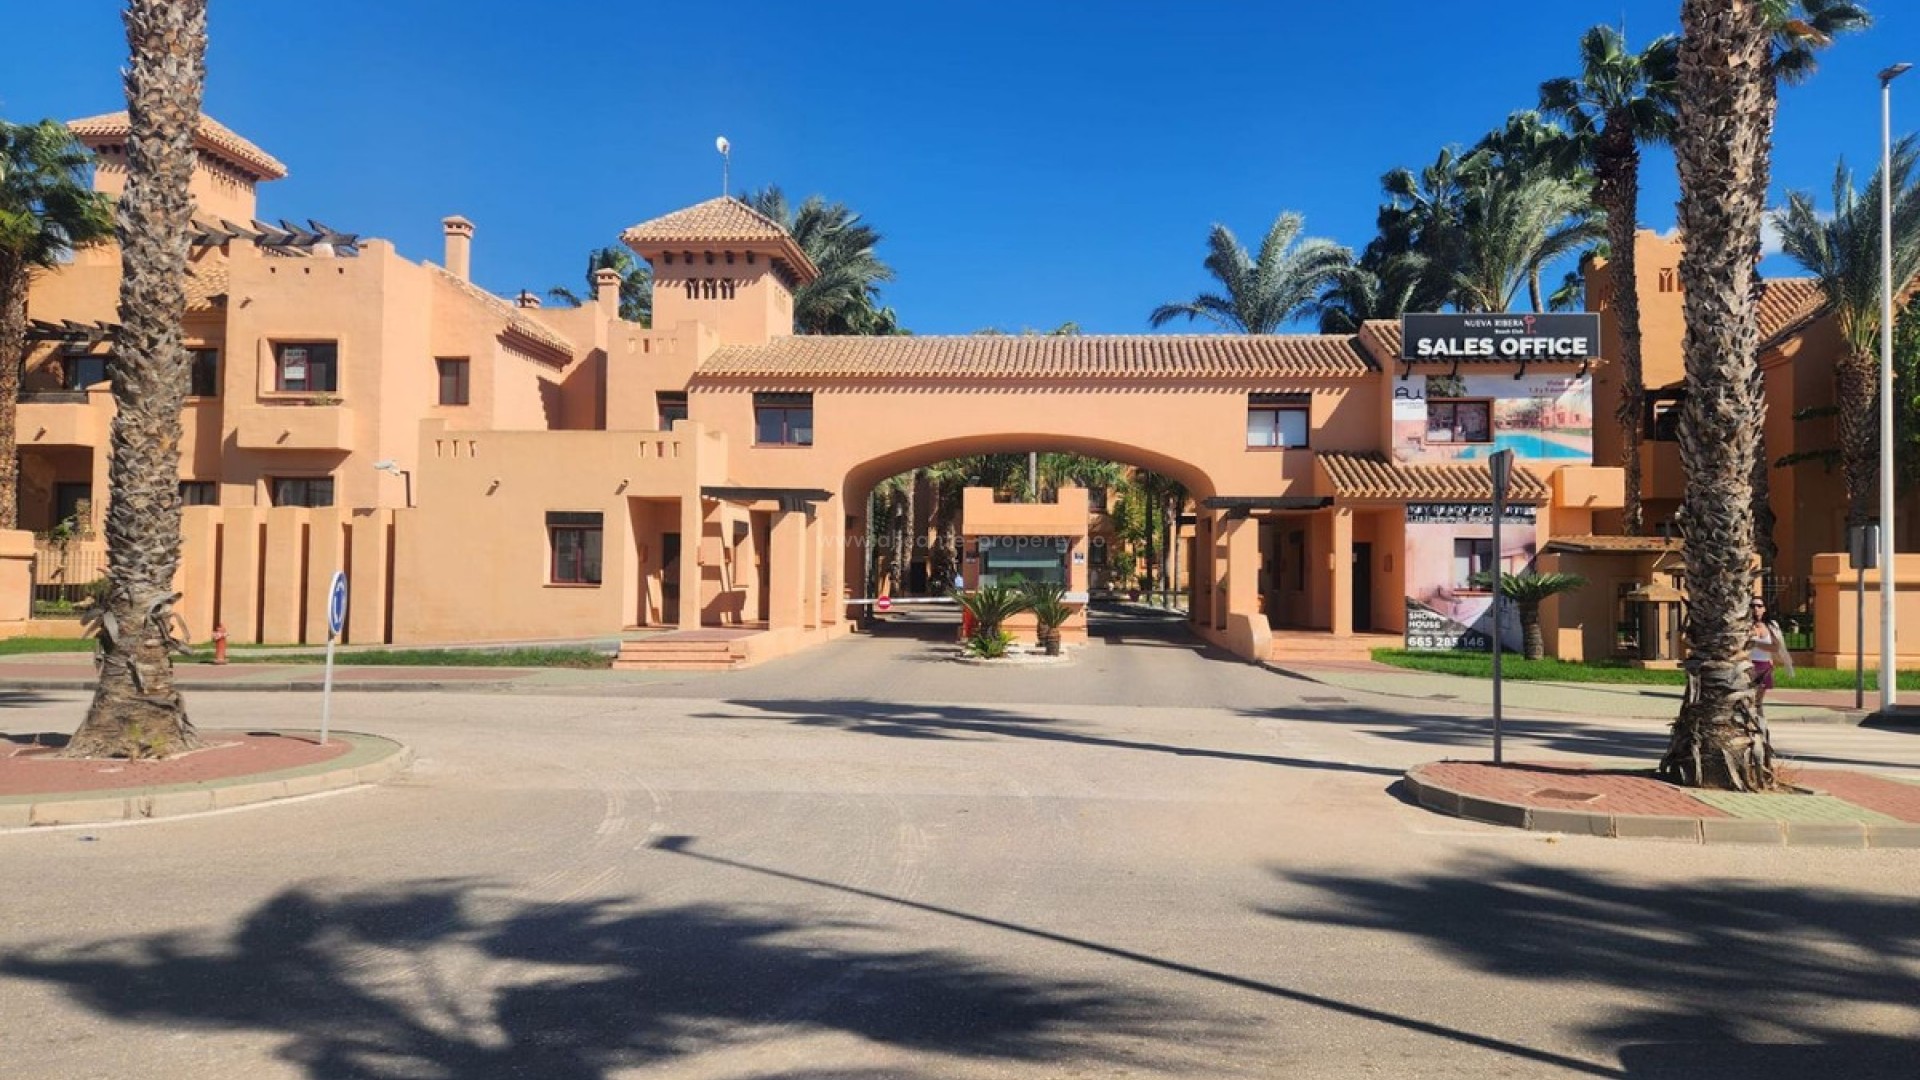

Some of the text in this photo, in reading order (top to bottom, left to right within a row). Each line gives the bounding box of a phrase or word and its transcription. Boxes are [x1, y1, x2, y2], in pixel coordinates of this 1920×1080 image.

[1464, 318, 1524, 328] NUEVA RIBERA
[1417, 337, 1588, 356] SALES OFFICE
[1408, 620, 1441, 629] HOUSE
[1408, 636, 1433, 647] 665
[1463, 637, 1485, 647] 146
